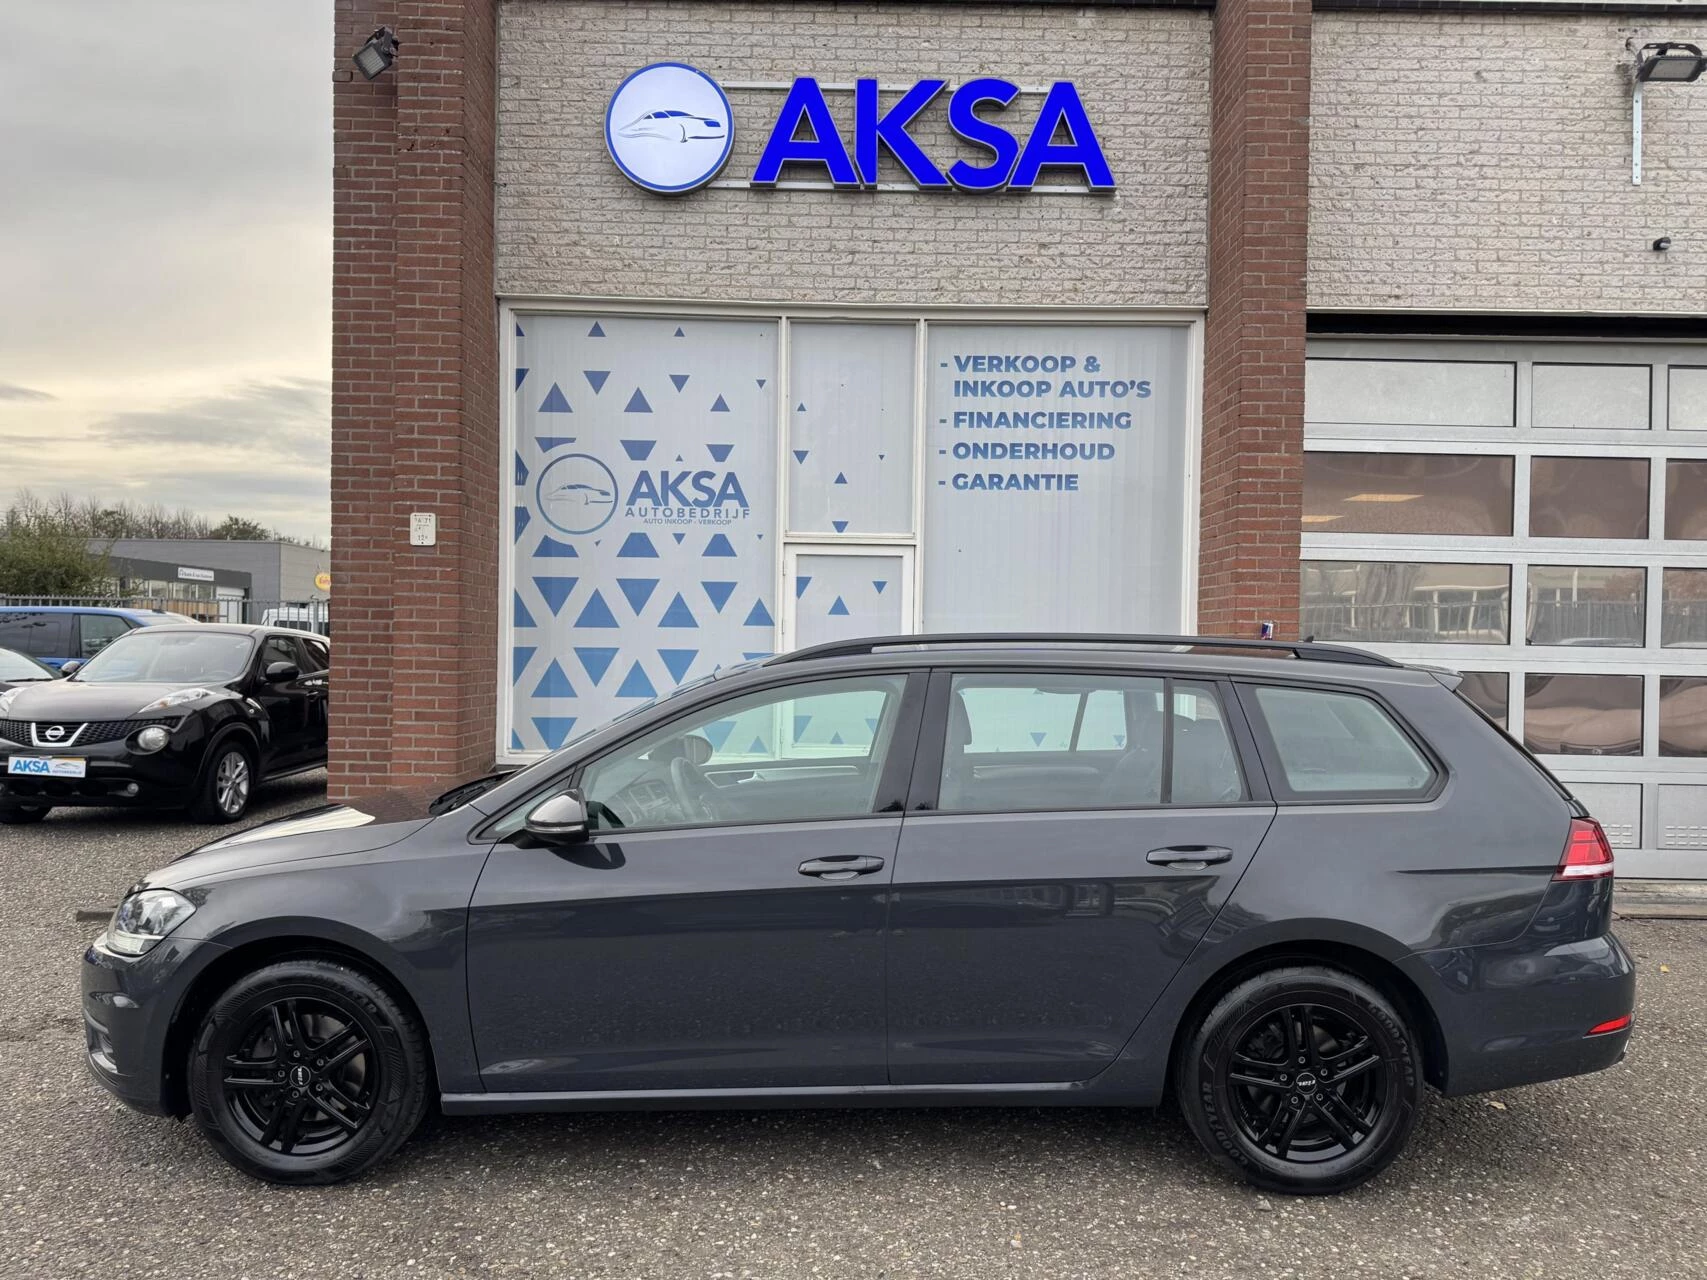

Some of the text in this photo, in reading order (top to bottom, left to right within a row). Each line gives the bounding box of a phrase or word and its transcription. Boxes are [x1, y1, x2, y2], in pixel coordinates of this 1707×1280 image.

[749, 75, 1116, 191] AKSA
[953, 355, 1077, 374] VERKOOP
[1083, 355, 1101, 374] &
[953, 379, 1152, 399] INKOOP AUTO'S
[953, 411, 1132, 430] FINANCIERING
[952, 442, 1115, 461] ONDERHOUD
[625, 470, 749, 508] AKSA
[951, 473, 1079, 491] GARANTIE
[625, 507, 750, 519] AUTOBEDRIJF
[12, 760, 51, 774] AKSA
[1202, 1081, 1249, 1167] GOODYEAR
